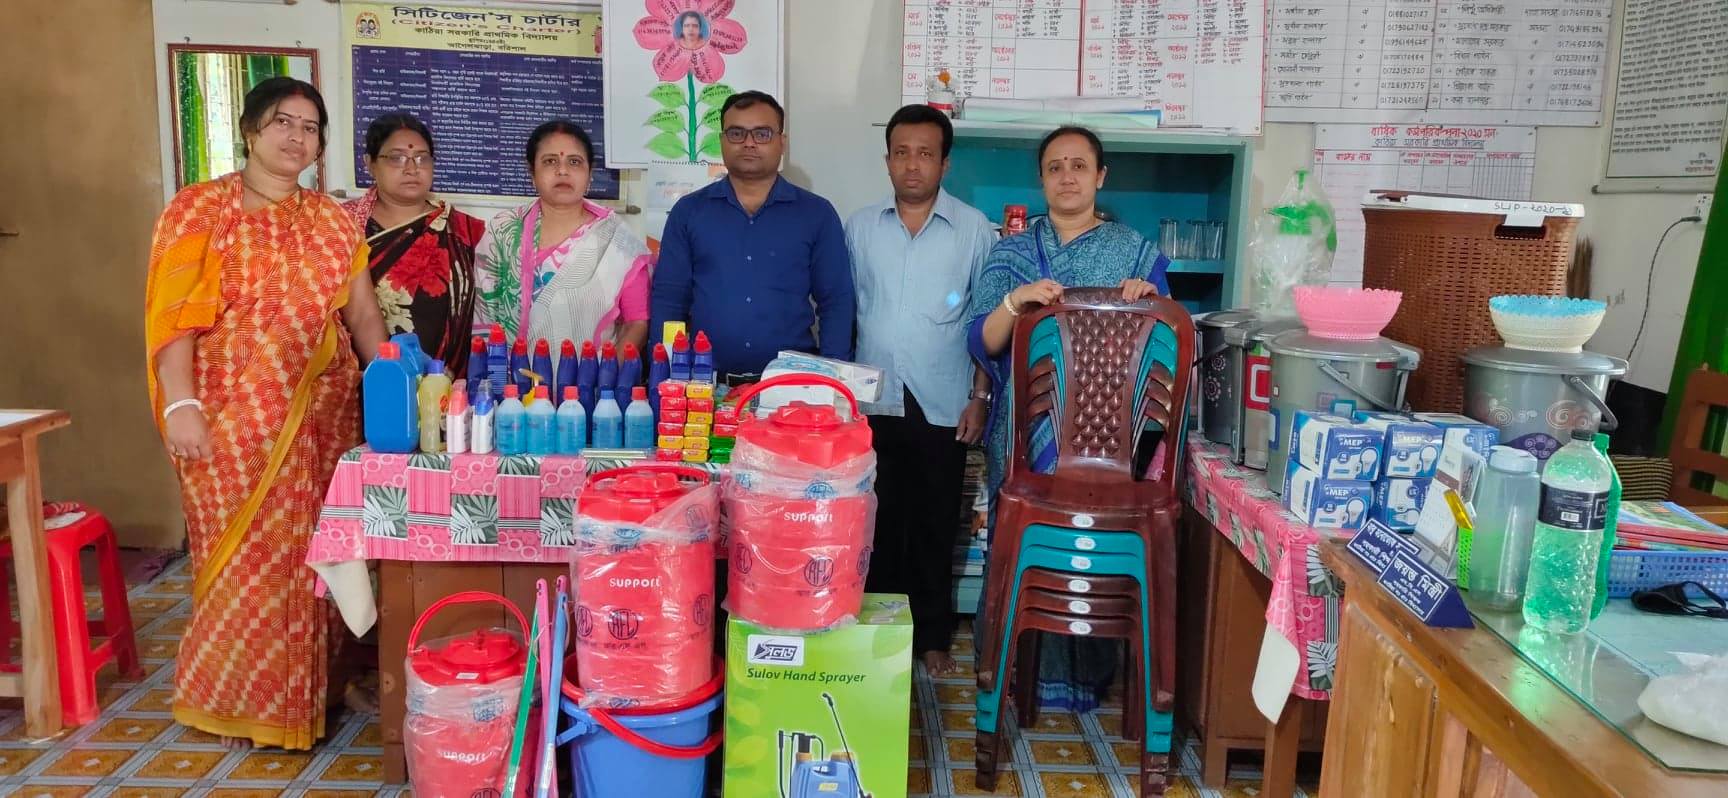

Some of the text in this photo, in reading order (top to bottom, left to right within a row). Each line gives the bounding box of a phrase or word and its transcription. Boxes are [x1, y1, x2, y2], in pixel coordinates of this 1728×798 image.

[521, 13, 581, 27] চার্টার
[1343, 438, 1363, 446] MEP
[1329, 488, 1349, 496] MEP
[747, 667, 866, 684] Sulov Hand Sprayer
